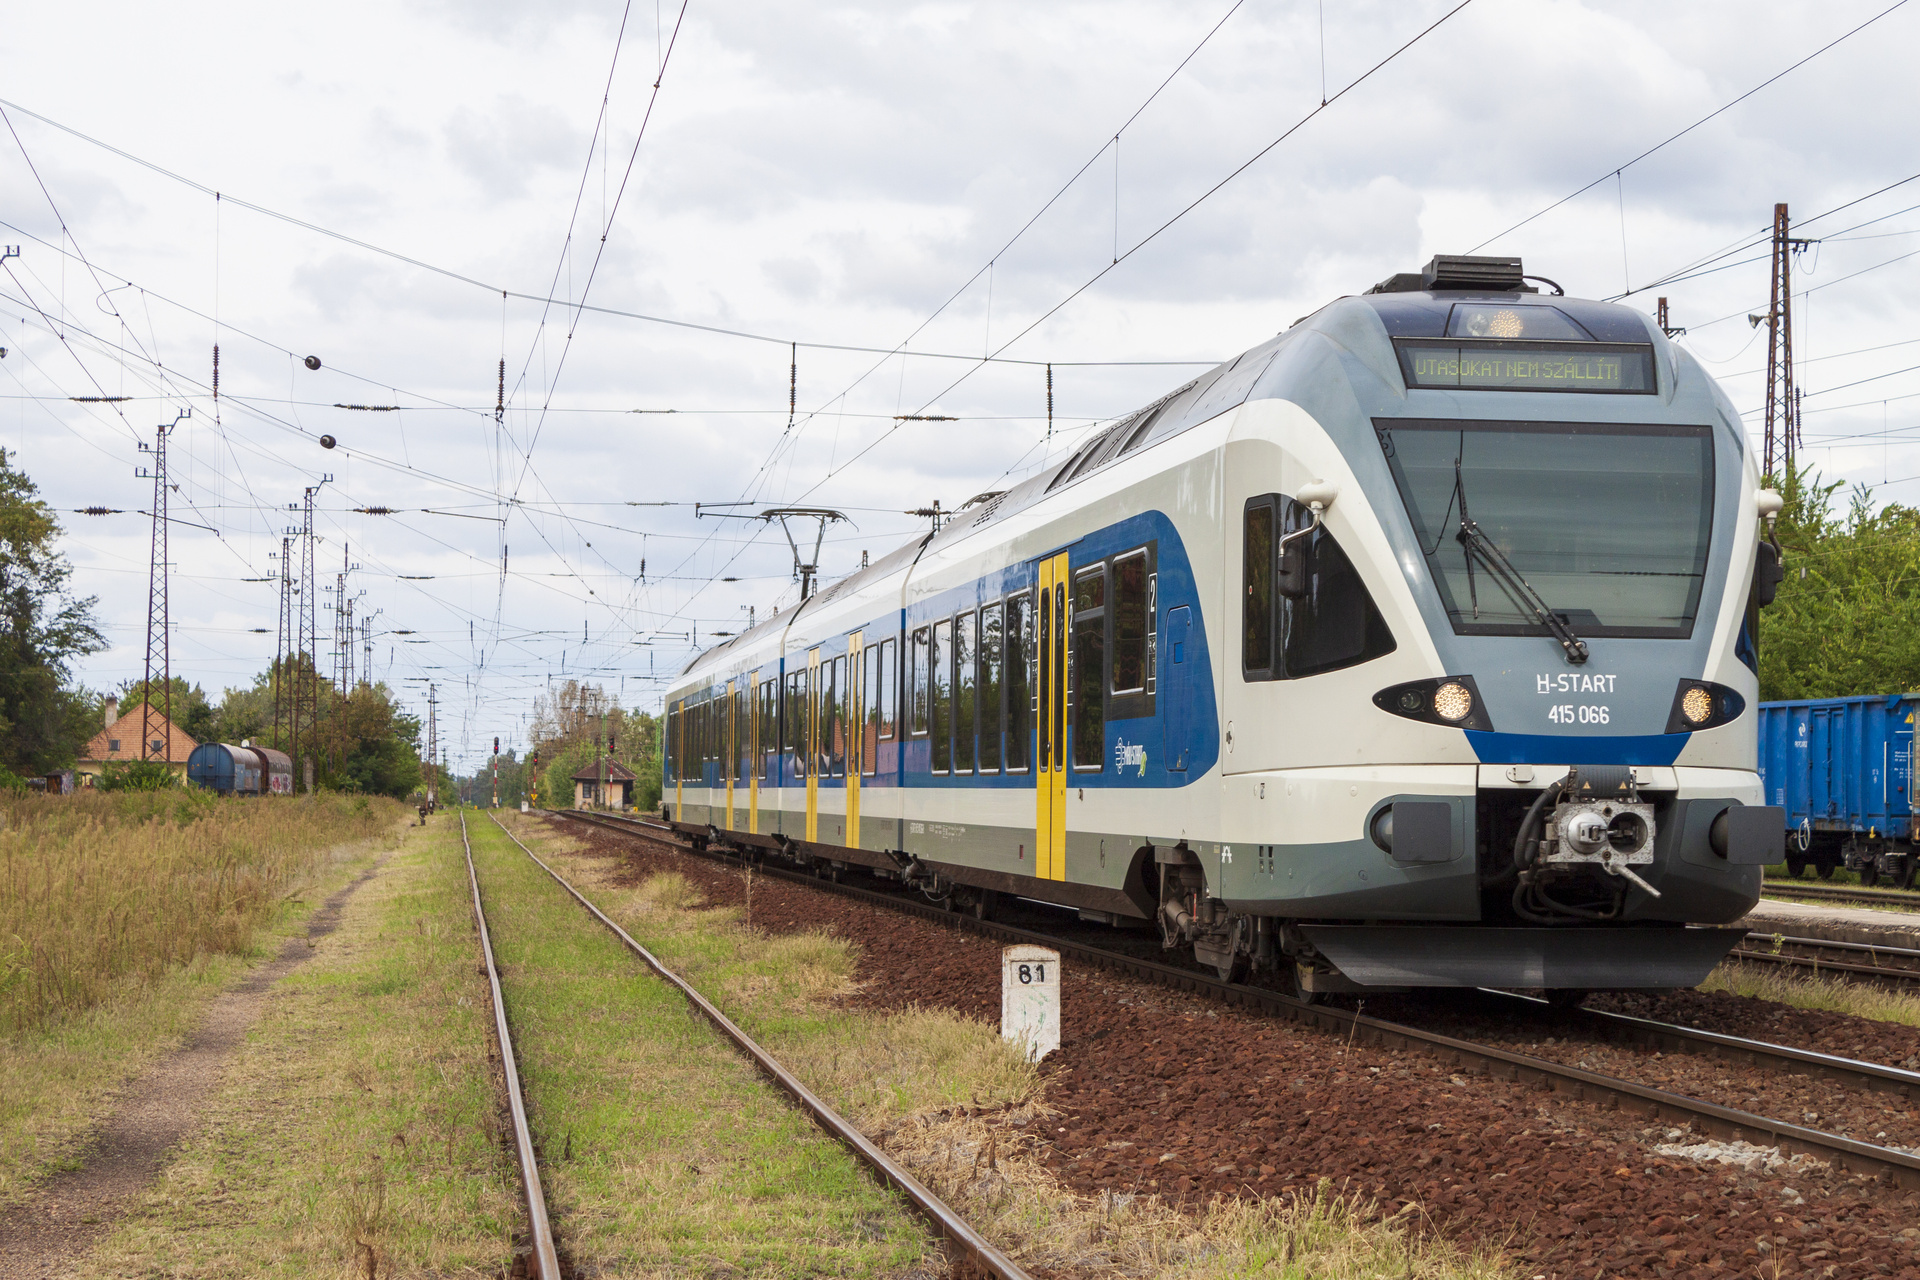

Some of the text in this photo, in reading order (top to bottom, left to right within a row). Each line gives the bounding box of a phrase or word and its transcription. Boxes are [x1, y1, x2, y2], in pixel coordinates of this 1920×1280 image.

[1415, 355, 1619, 380] UTASOKAT NEM SZÁLLÍT!
[1150, 579, 1156, 612] 2
[1068, 603, 1074, 633] 2
[1536, 673, 1617, 694] H-START
[1548, 704, 1610, 724] 415 066
[1018, 964, 1045, 985] 81
